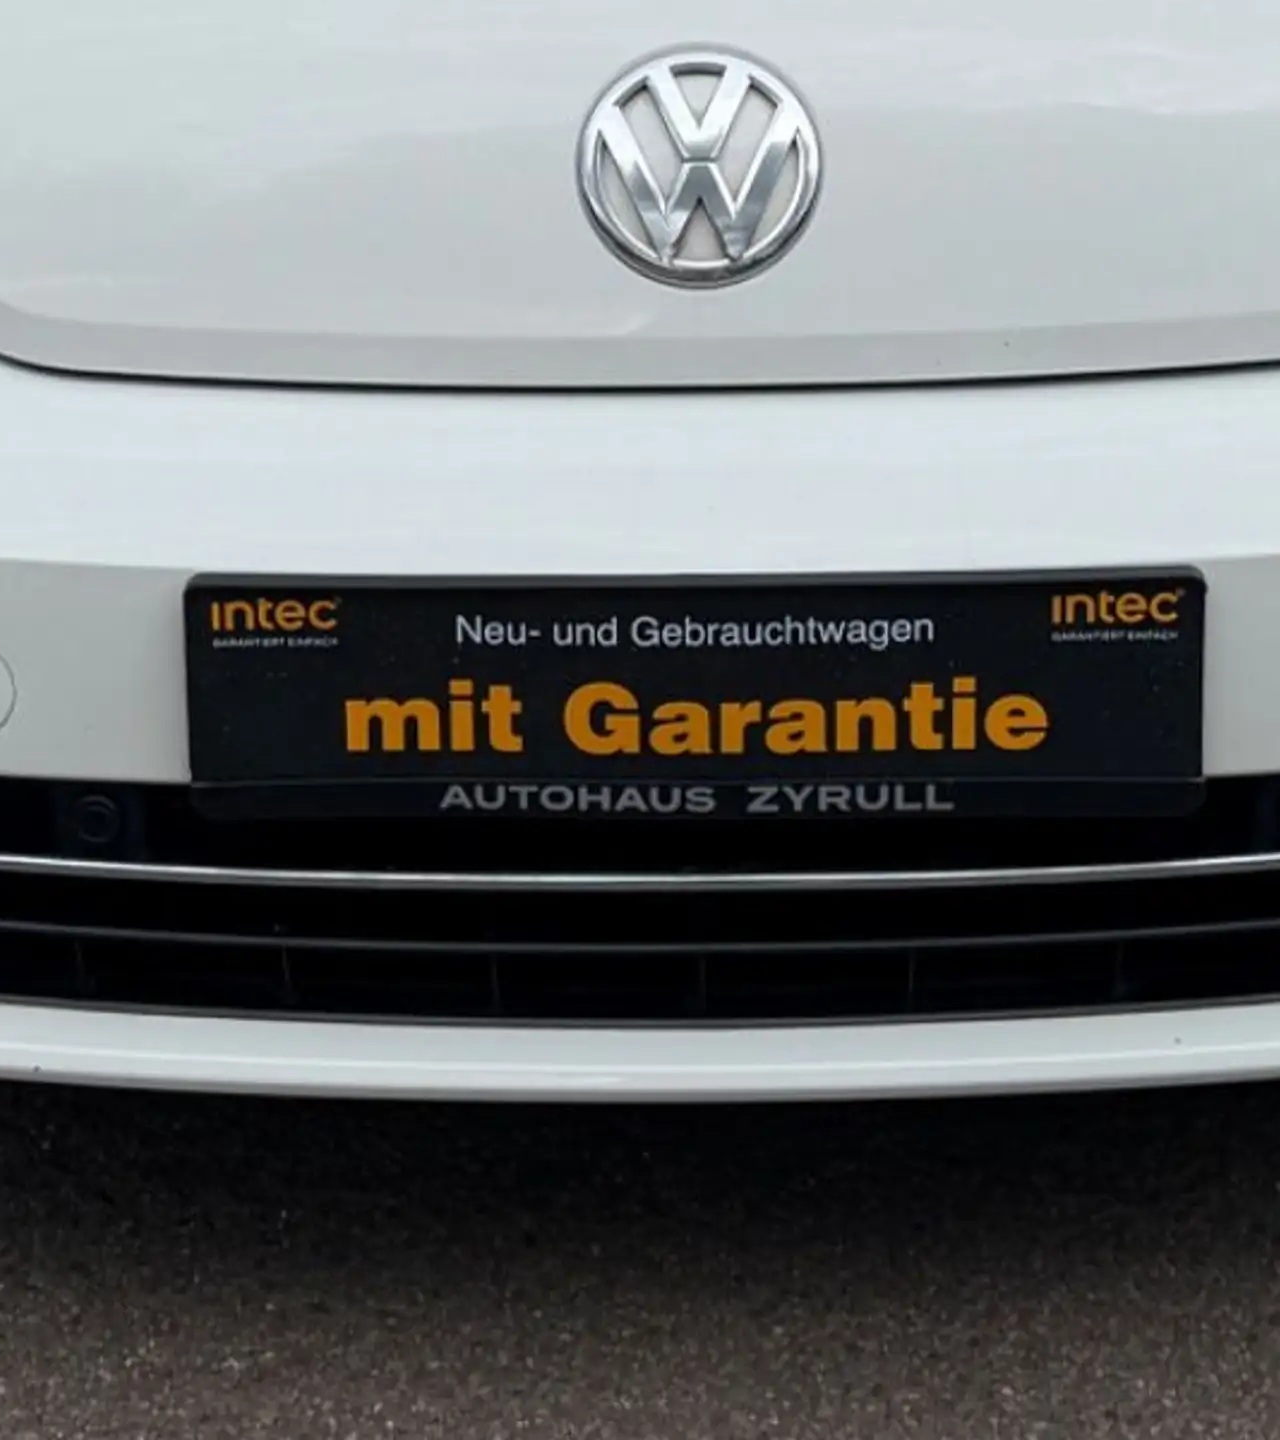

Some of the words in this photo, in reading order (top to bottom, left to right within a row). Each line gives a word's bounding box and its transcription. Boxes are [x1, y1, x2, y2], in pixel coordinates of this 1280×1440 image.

[211, 596, 338, 632] intec
[1051, 589, 1179, 625] intec
[455, 614, 541, 646] Neu-
[553, 615, 618, 647] und
[630, 614, 935, 651] Gebrauchtwagen
[344, 678, 523, 752] mit
[563, 676, 1049, 755] Garantie
[439, 784, 717, 814] AUTOHAUS
[746, 783, 955, 814] ZYRULL
